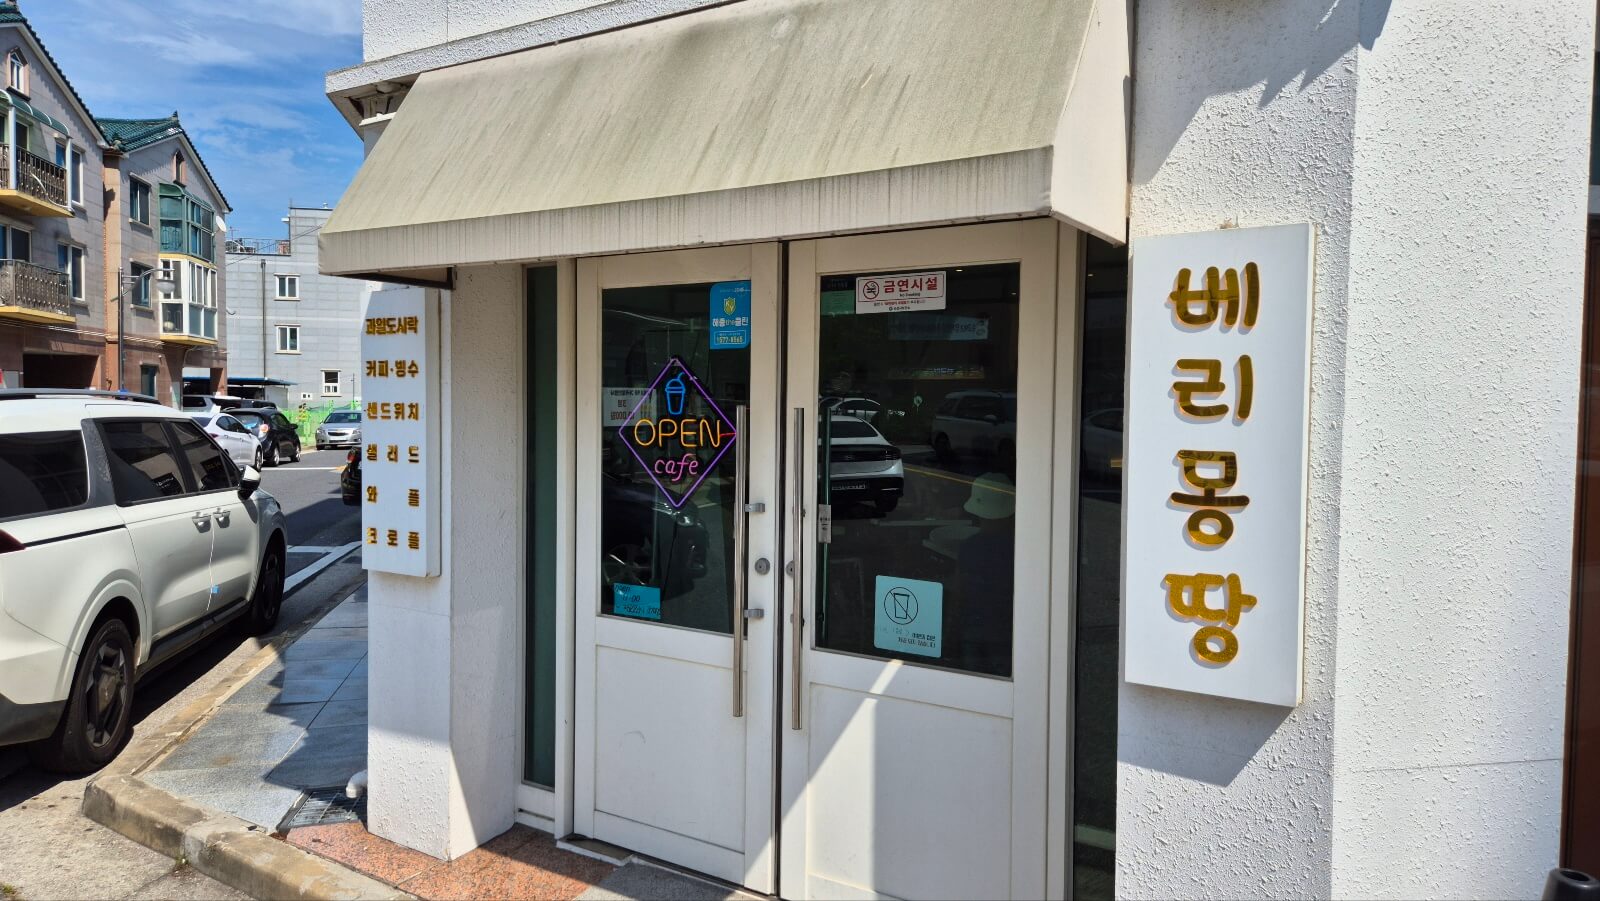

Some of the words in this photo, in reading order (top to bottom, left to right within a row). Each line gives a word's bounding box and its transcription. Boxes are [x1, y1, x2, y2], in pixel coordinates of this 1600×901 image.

[883, 276, 938, 294] 금연시설
[365, 315, 419, 335] 과일도시락
[634, 418, 721, 449] OPEN
[654, 453, 699, 482] cafe
[1165, 261, 1260, 665] 베리몽땅
